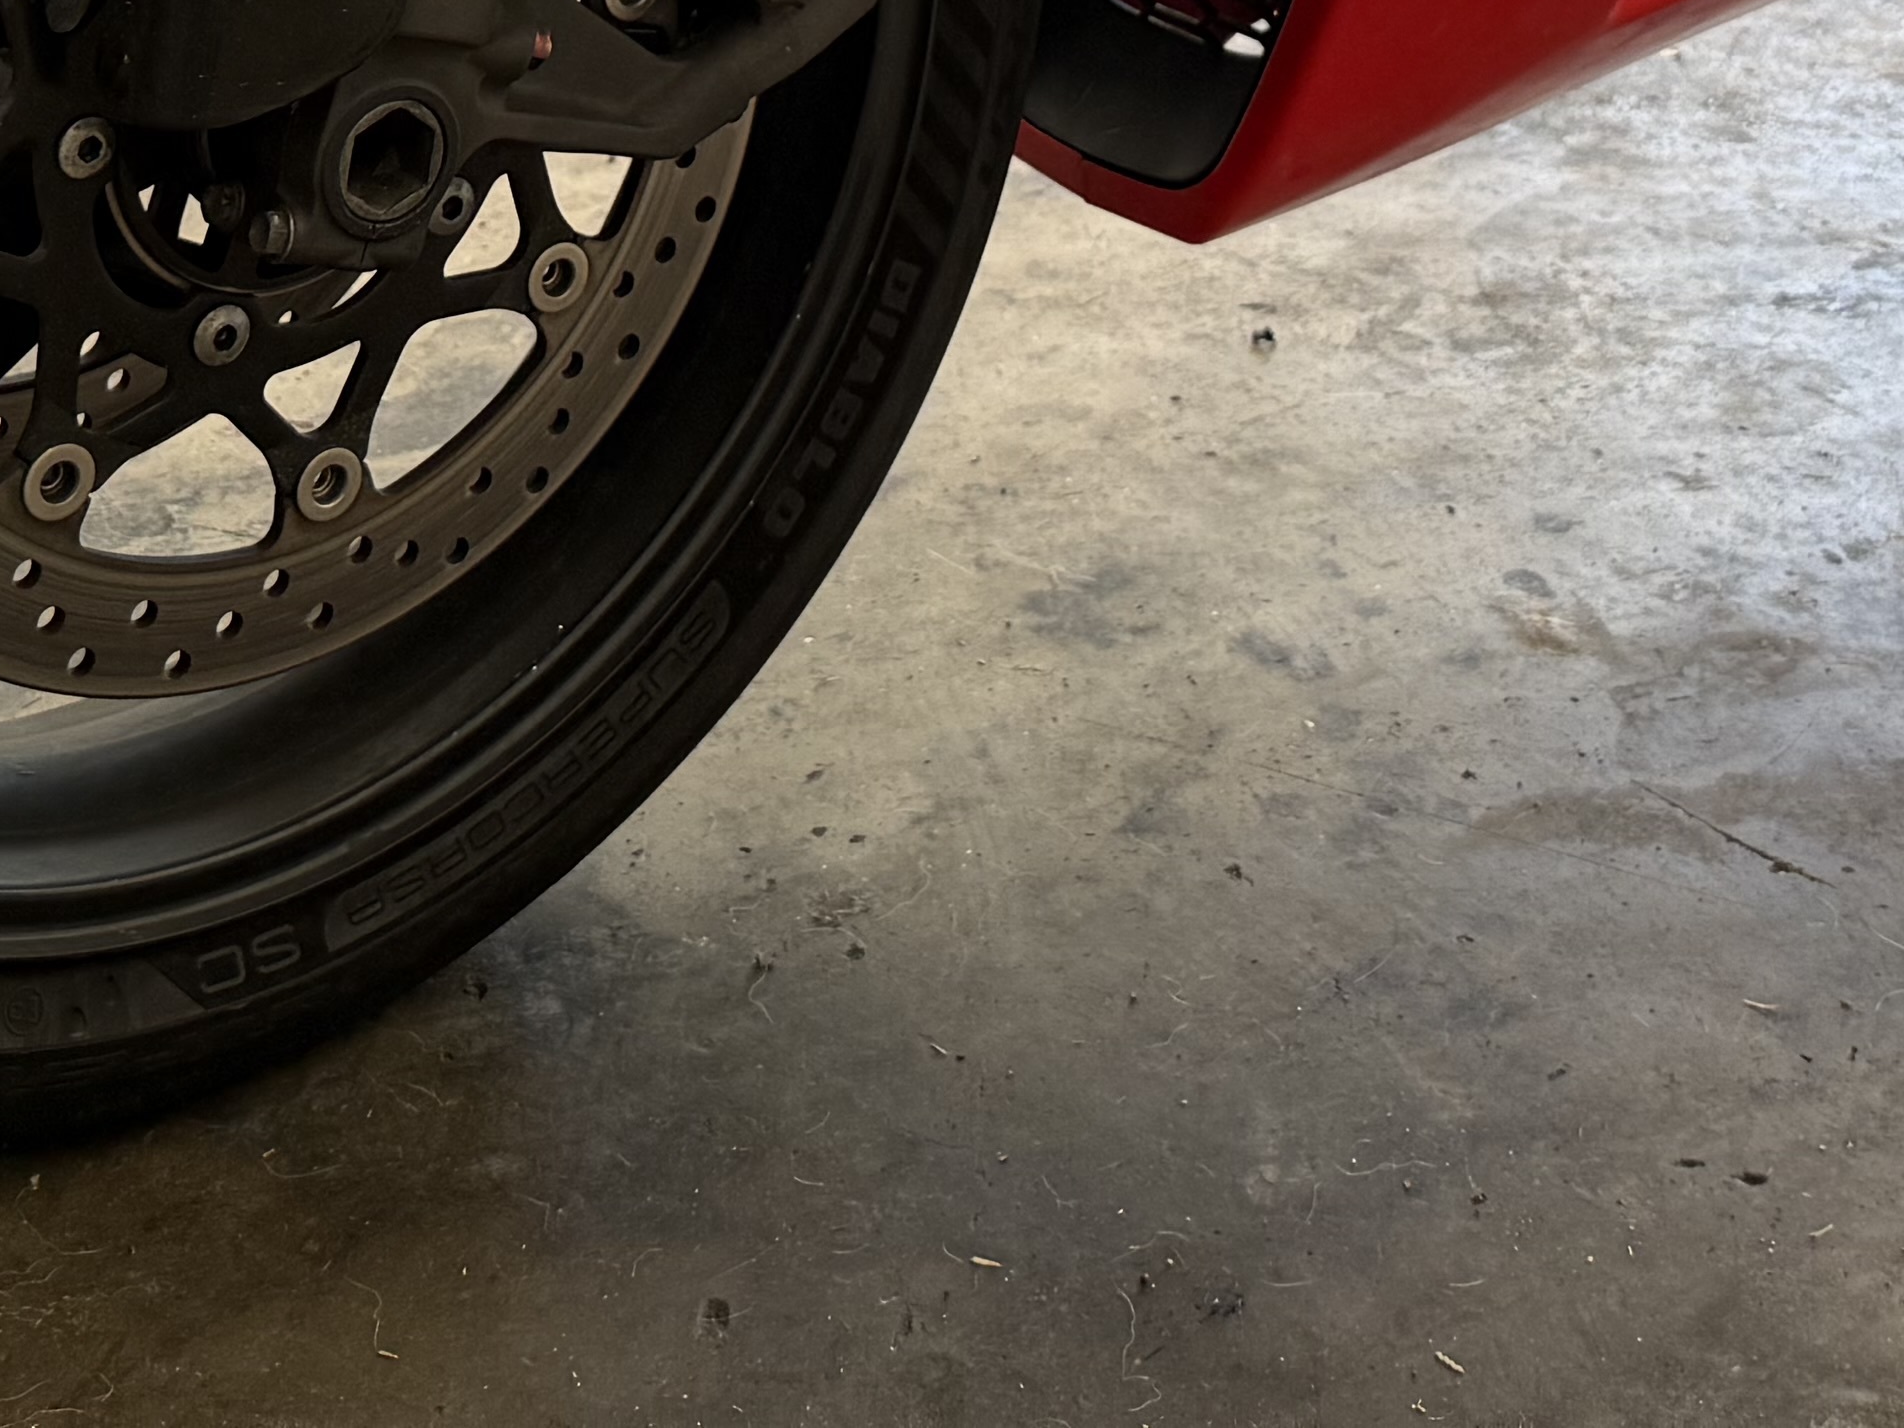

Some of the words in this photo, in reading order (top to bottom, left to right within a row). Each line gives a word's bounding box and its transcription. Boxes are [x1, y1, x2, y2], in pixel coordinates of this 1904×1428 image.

[761, 257, 923, 540] DIABLO
[347, 608, 718, 928] SUPERCORSA
[198, 923, 302, 994] SC
